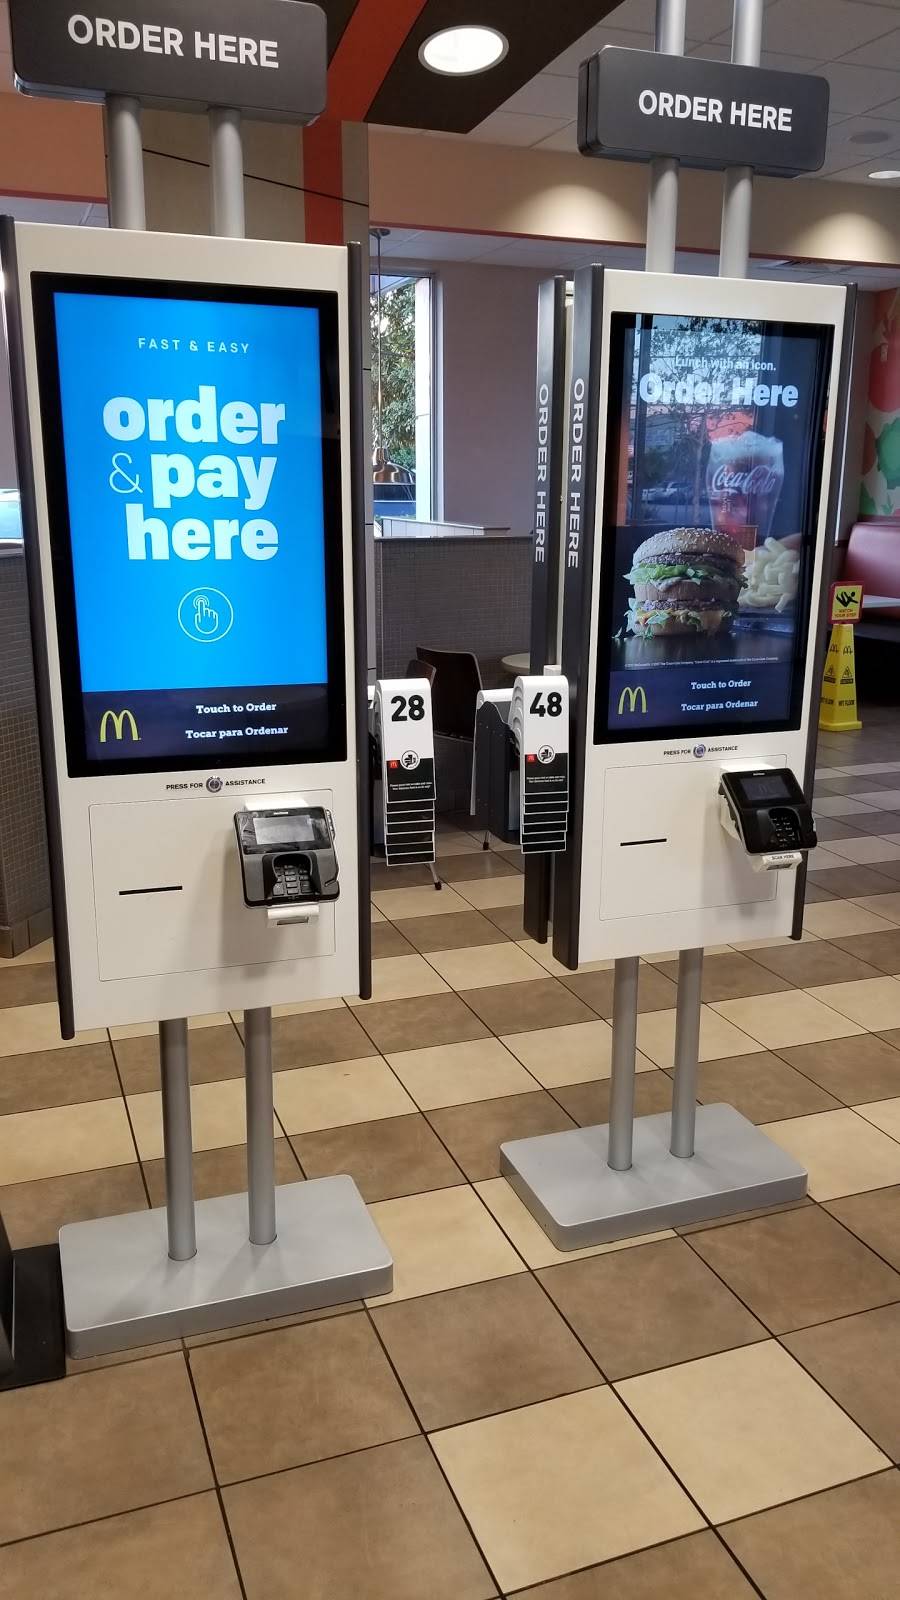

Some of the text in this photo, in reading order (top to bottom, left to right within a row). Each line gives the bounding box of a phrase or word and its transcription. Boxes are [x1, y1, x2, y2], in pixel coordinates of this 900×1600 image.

[67, 14, 279, 69] ORDER HERE
[638, 89, 793, 132] ORDER HERE
[138, 337, 250, 354] FAST & EASY
[675, 355, 706, 368] Lunch
[710, 357, 734, 369] with
[735, 360, 750, 370] an
[639, 372, 799, 408] Order Here
[102, 385, 286, 445] order
[109, 452, 278, 511] & pay
[535, 383, 549, 563] ORDER HERE
[568, 378, 585, 568] ORDER HERE
[125, 503, 279, 561] here
[690, 681, 717, 690] Touch
[728, 679, 752, 688] Order
[196, 702, 277, 714] Touch to Order
[390, 694, 425, 722] 28
[529, 691, 562, 718] 48
[680, 700, 759, 712] Tocar para Ordenar
[185, 726, 289, 740] Tocar para Ordenar
[225, 778, 266, 786] ASSISTANCE
